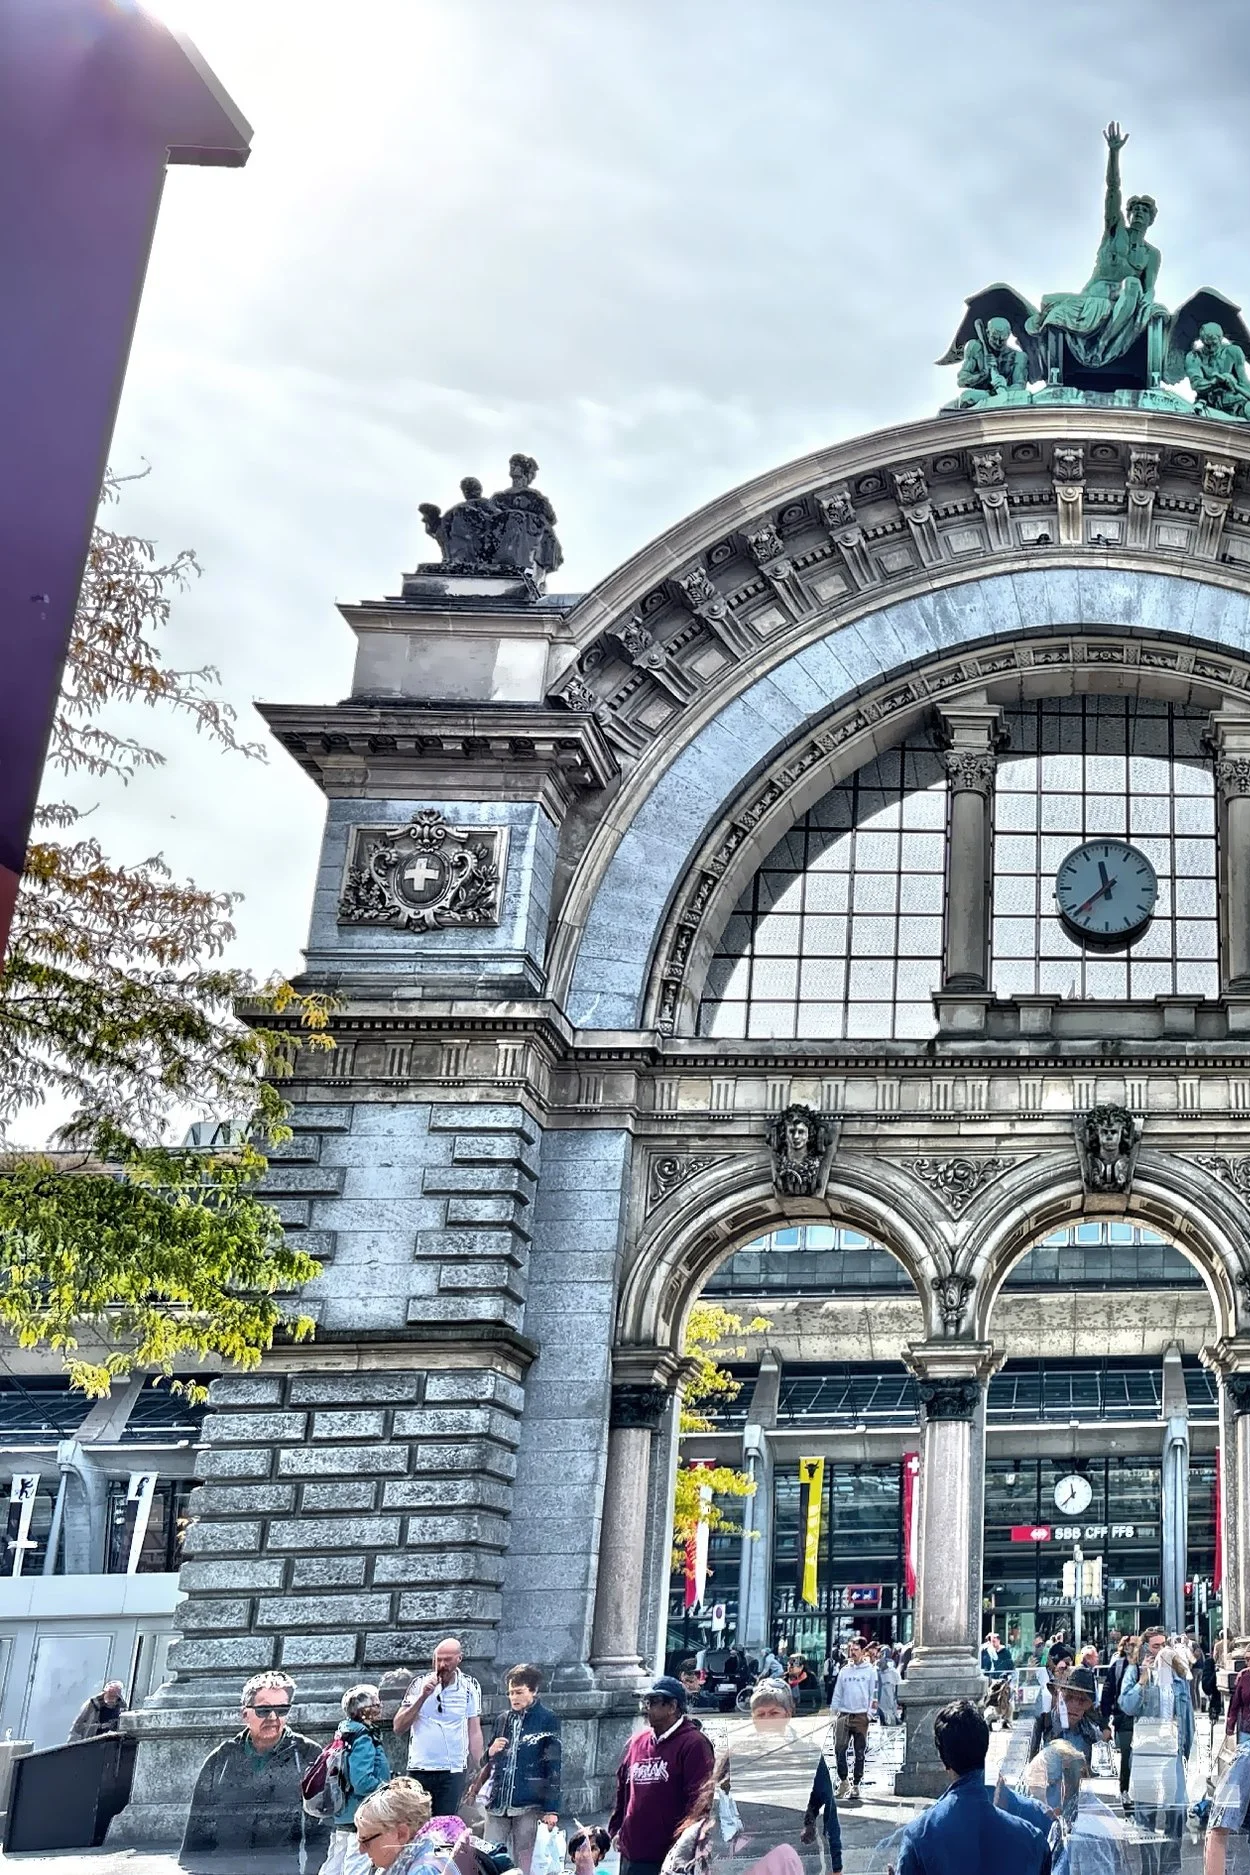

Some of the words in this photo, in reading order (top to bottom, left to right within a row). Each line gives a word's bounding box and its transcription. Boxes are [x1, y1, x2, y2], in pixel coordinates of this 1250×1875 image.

[1054, 1527, 1082, 1540] SBB
[1085, 1526, 1108, 1539] CFF
[1111, 1526, 1135, 1538] FFS
